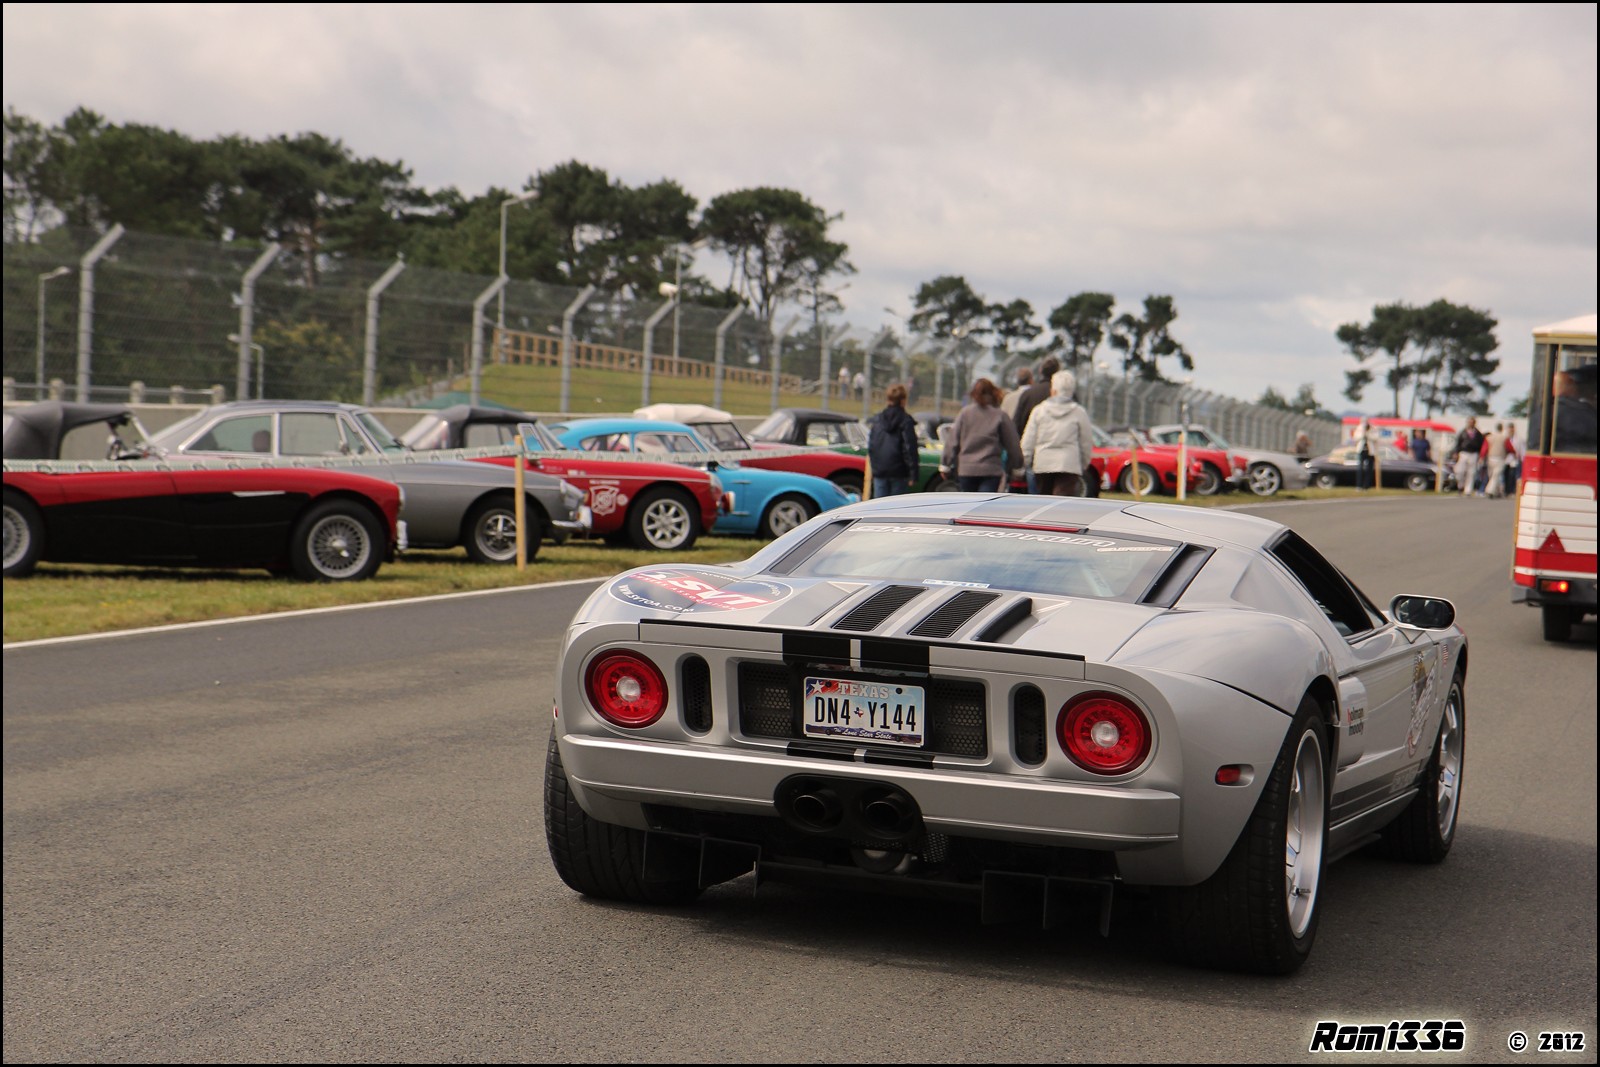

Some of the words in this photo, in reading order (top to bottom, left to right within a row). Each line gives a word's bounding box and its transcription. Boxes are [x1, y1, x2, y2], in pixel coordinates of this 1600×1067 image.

[667, 580, 769, 605] SVT
[837, 682, 890, 699] TEXAS
[814, 696, 851, 726] DN4
[867, 701, 917, 732] Y144
[842, 728, 858, 736] Lone
[859, 729, 874, 738] Star
[875, 731, 893, 740] State
